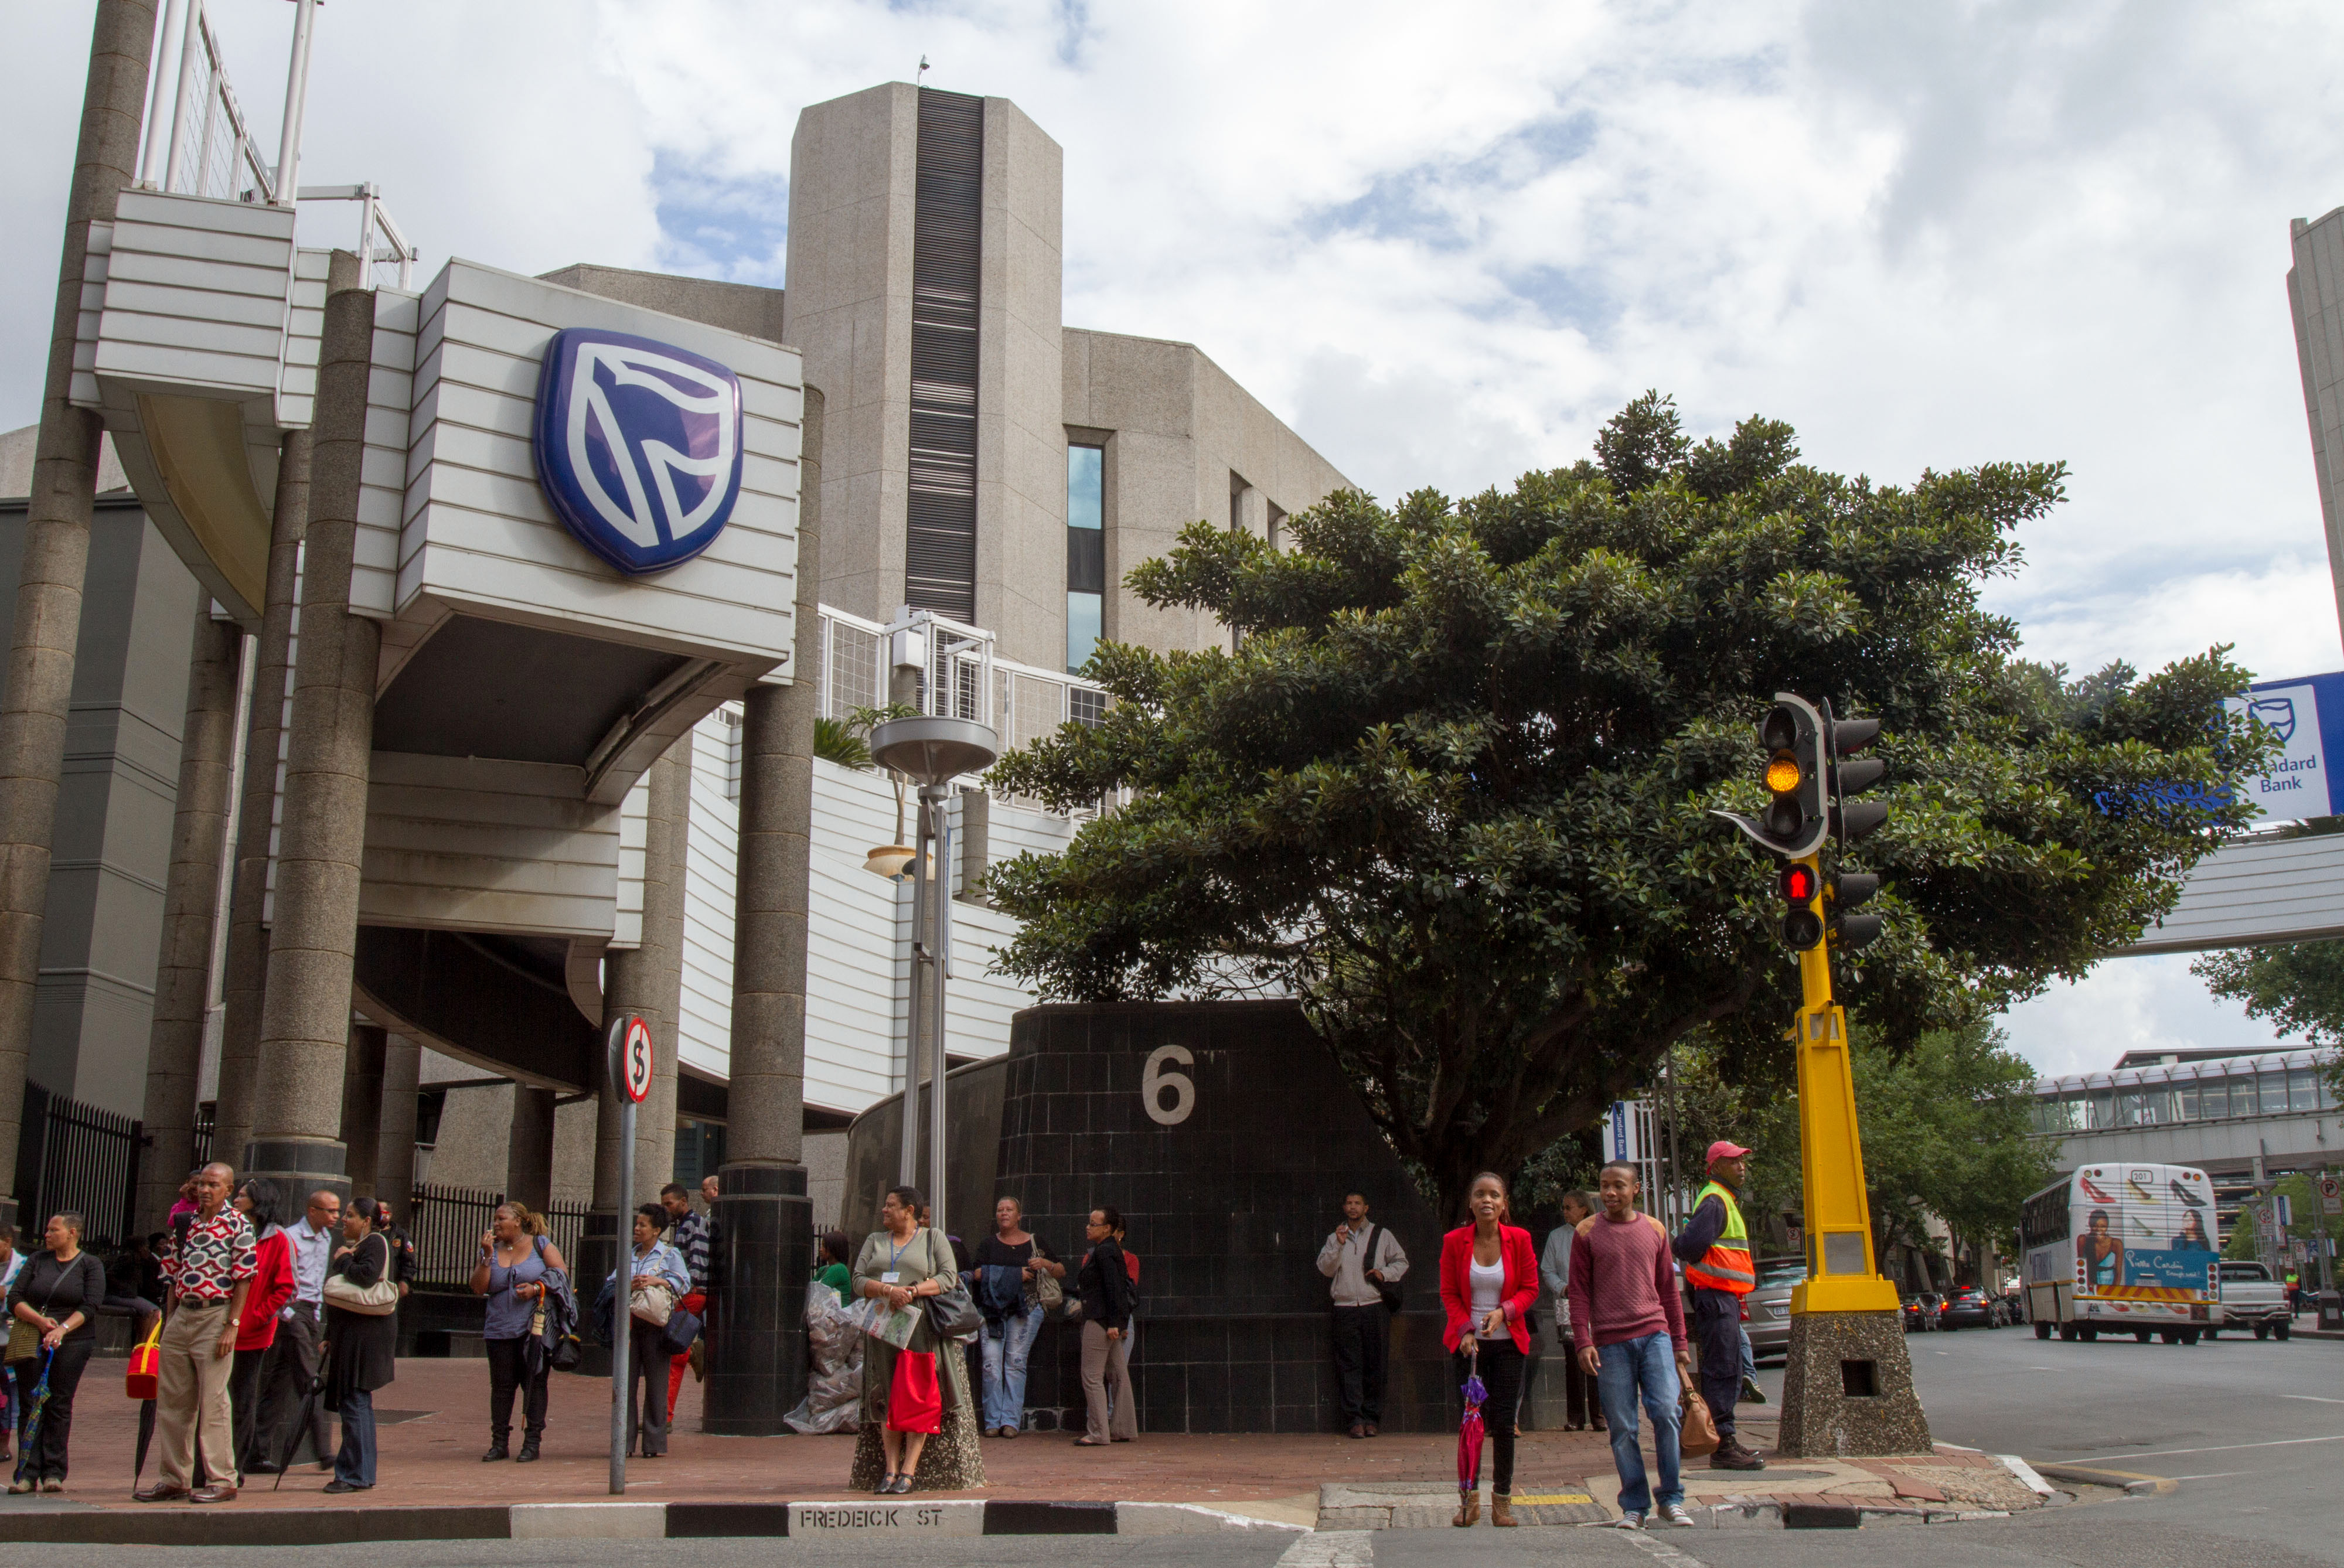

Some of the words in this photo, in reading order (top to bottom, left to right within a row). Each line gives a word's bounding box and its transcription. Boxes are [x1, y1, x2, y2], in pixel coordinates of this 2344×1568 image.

[2254, 755, 2316, 774] ndard
[2260, 775, 2302, 793] Bank
[633, 1039, 645, 1085] S
[1142, 1044, 1195, 1126] 6
[2153, 1256, 2183, 1270] Cardin
[800, 1509, 899, 1528] FREDEICK
[917, 1509, 942, 1526] ST
